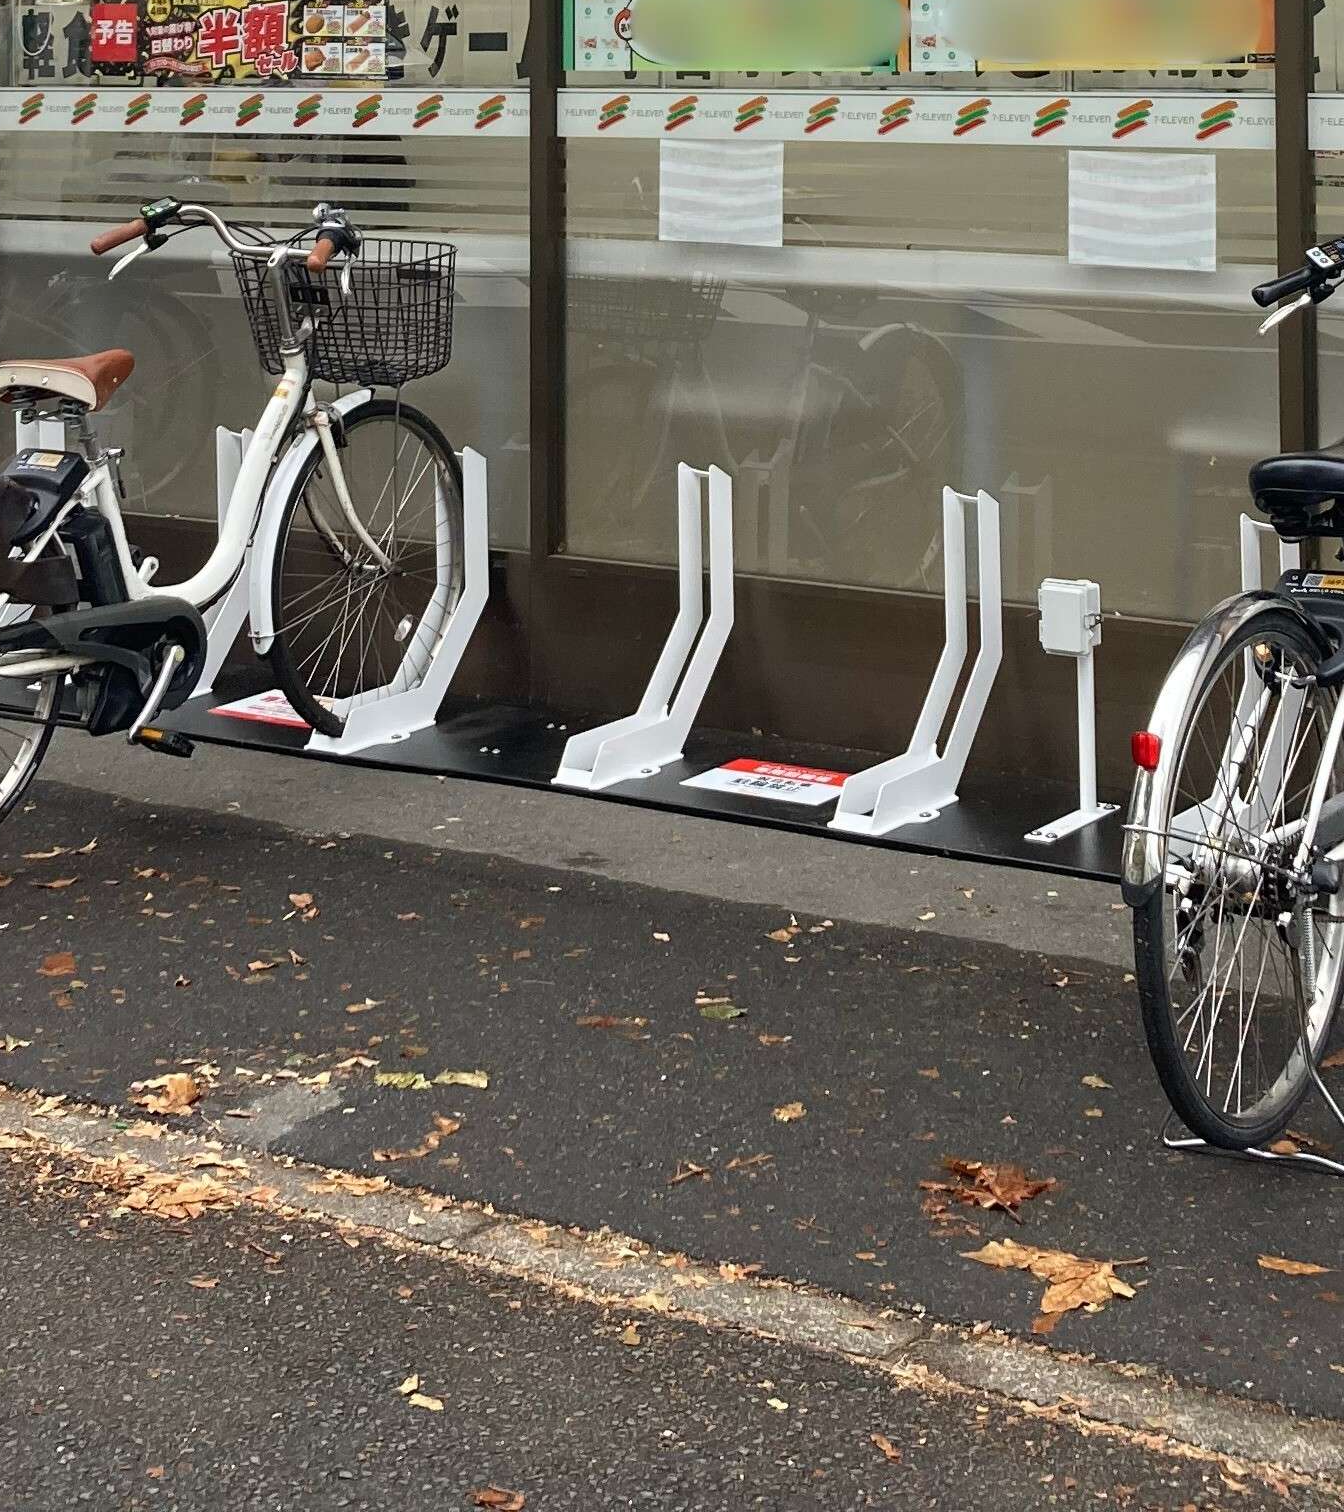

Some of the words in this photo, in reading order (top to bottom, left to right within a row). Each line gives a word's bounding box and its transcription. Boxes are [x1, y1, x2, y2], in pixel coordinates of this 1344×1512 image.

[95, 18, 135, 45] 予告
[199, 0, 289, 70] 半額
[256, 50, 298, 76] セール
